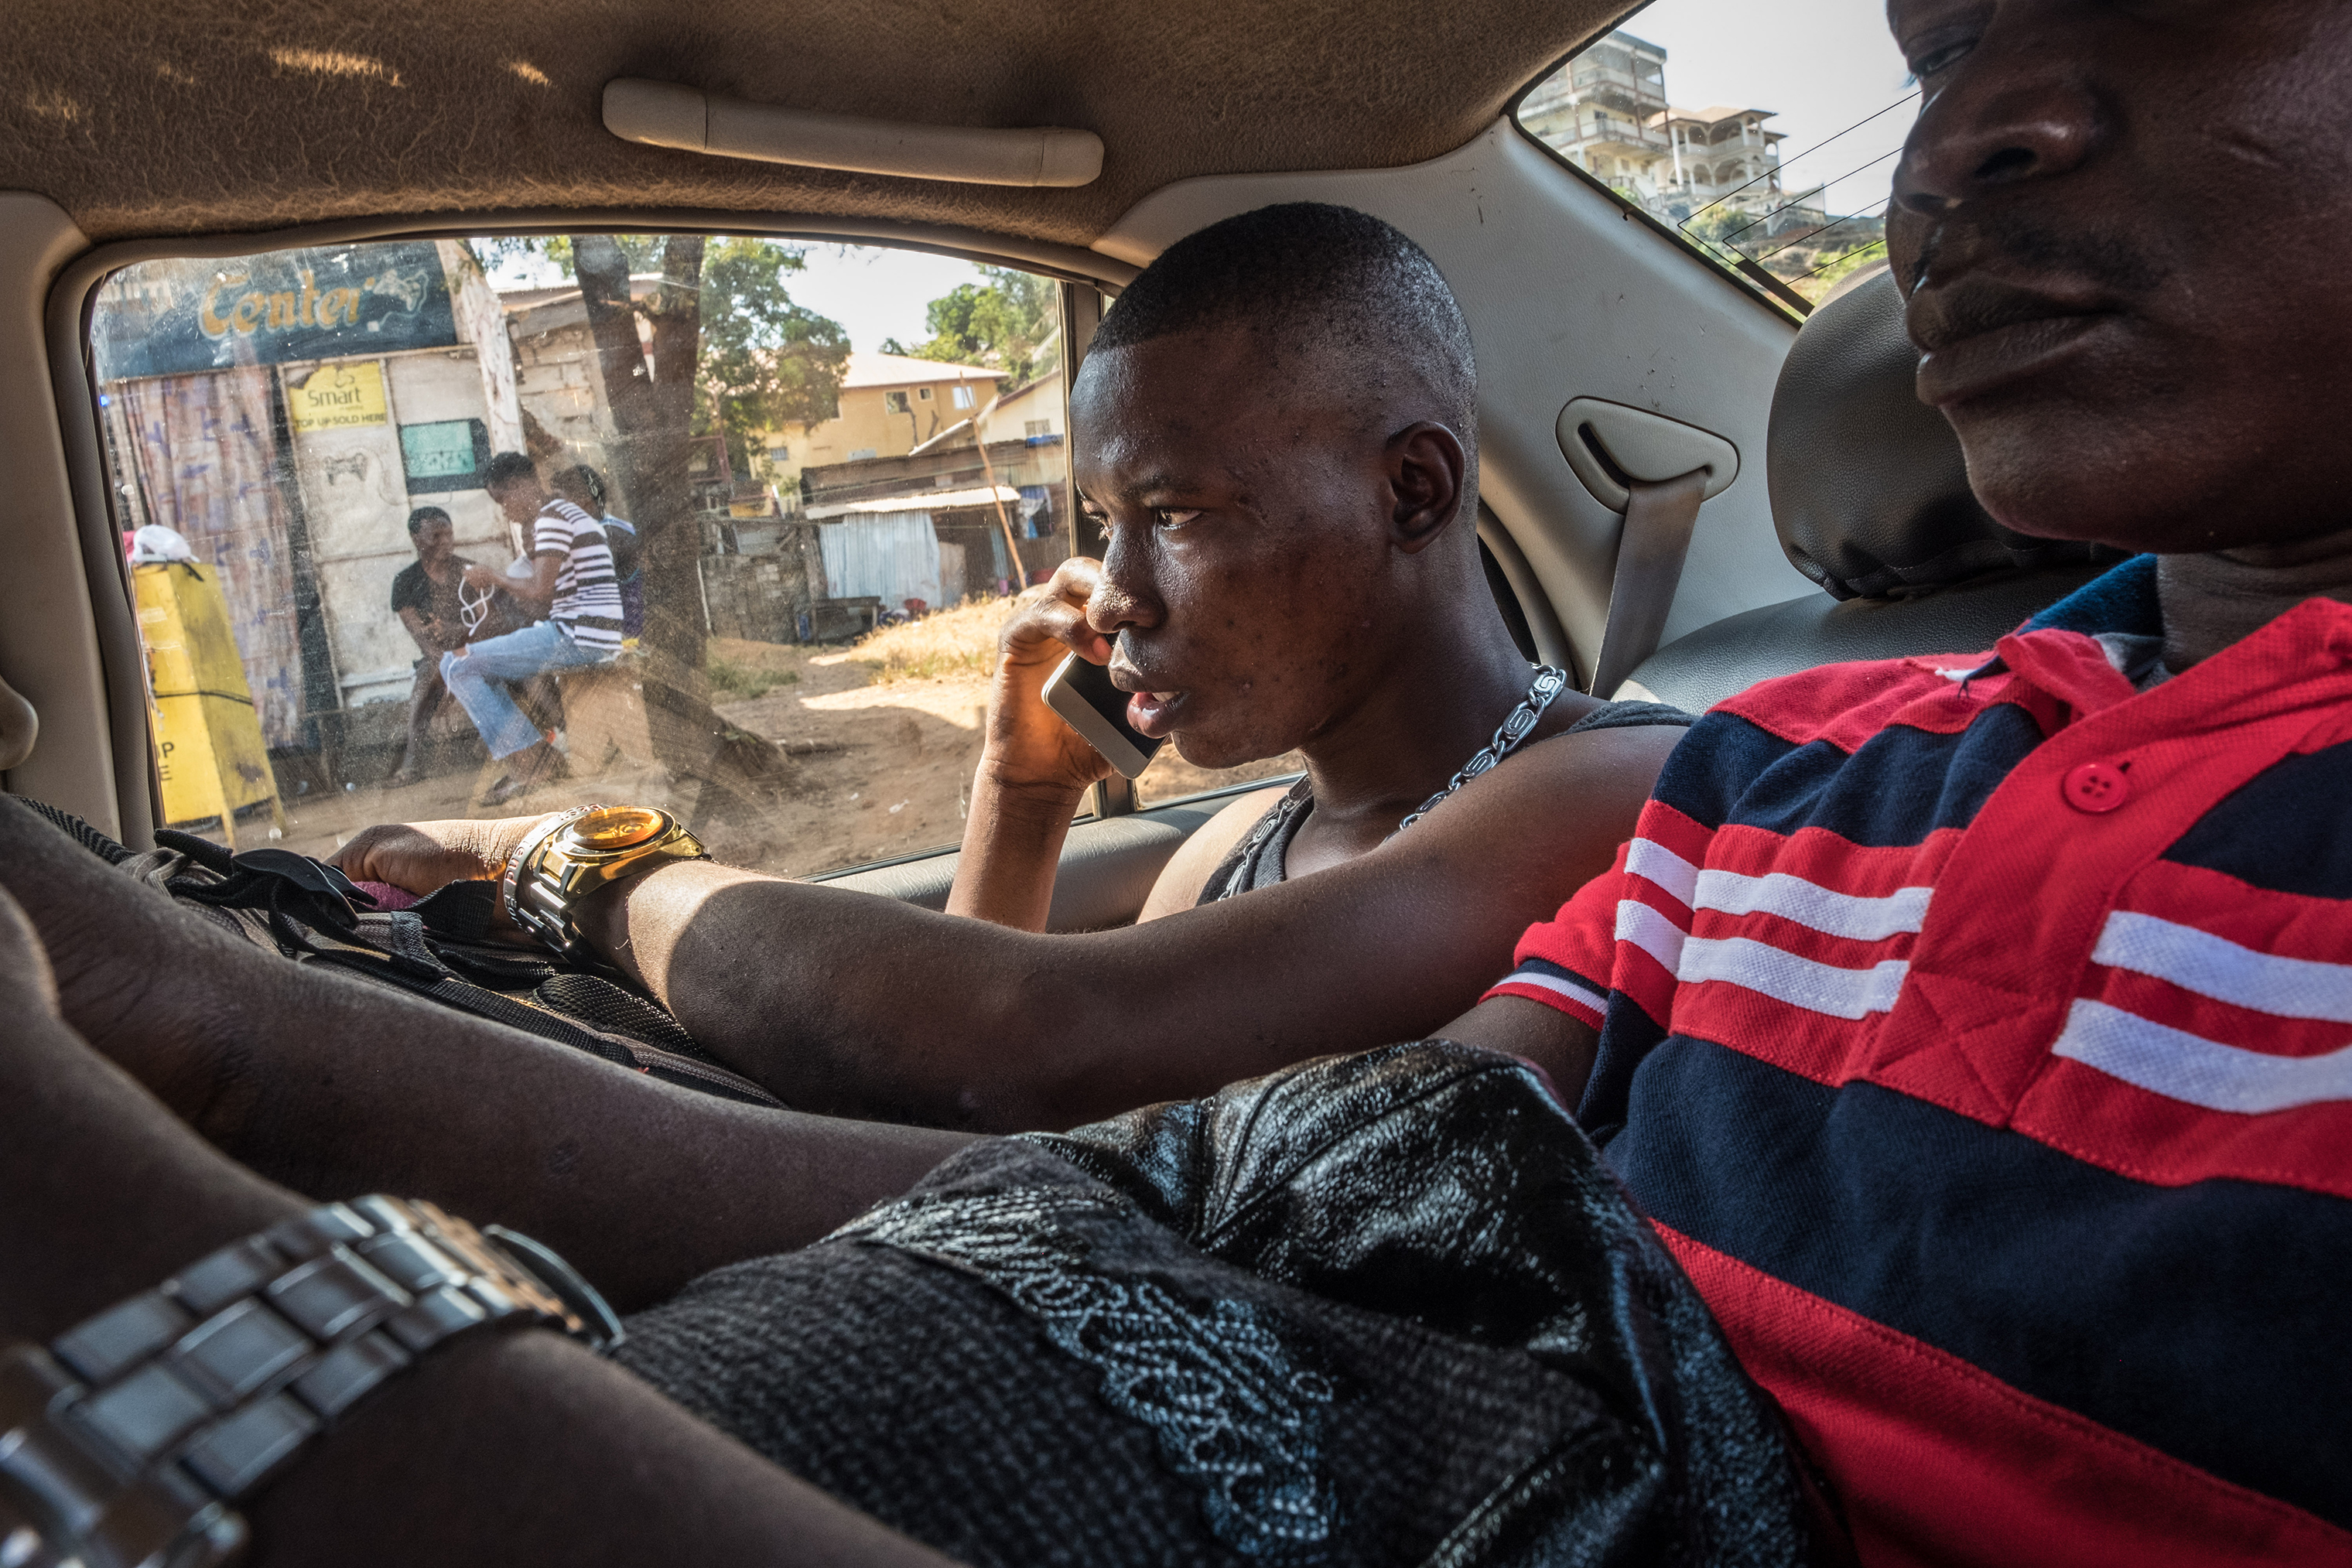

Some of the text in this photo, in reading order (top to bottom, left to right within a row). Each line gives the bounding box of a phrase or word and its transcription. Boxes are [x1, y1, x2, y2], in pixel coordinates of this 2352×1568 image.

[199, 268, 375, 339] Center
[308, 388, 361, 407] Smart
[296, 413, 385, 429] TOP UP SOLD HERE
[156, 742, 174, 759] P
